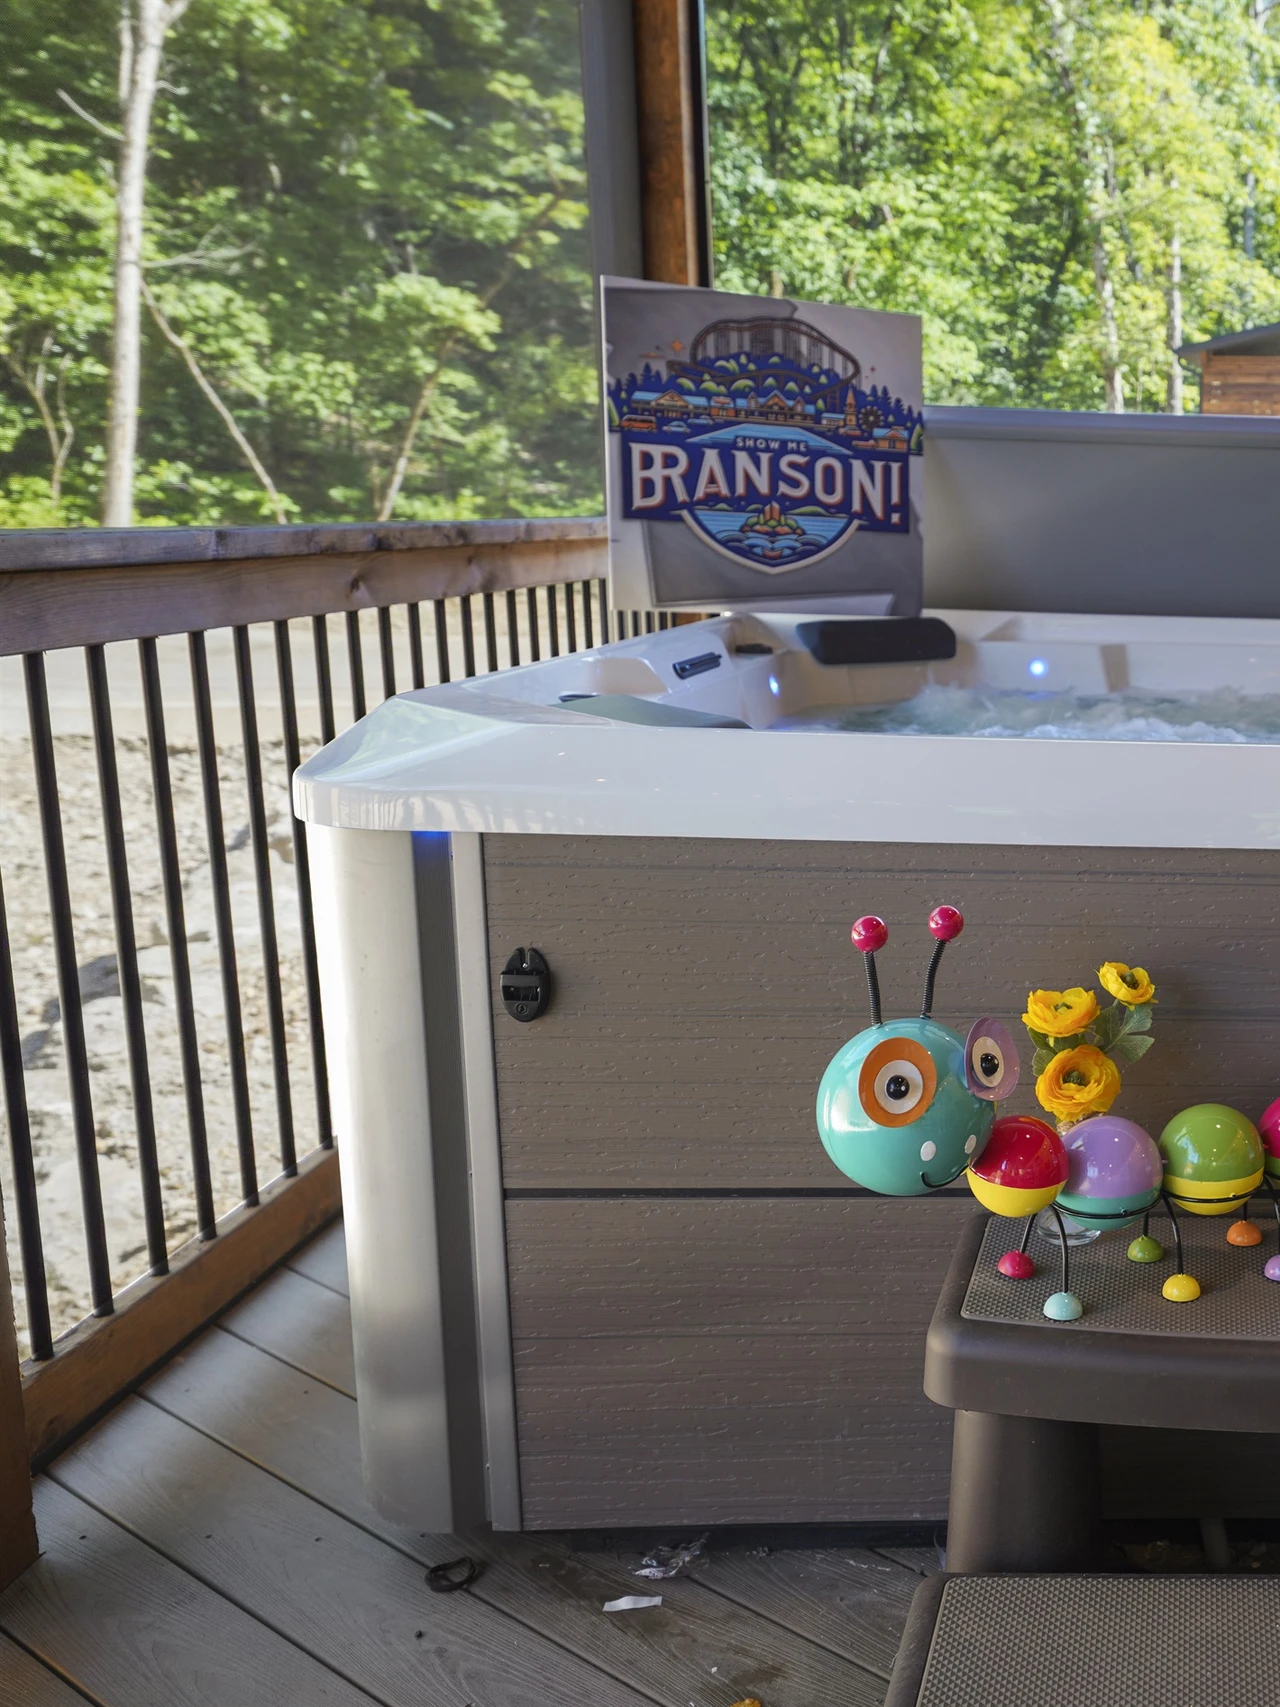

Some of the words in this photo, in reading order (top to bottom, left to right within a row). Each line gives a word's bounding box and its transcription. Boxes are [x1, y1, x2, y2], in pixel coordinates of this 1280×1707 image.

[736, 437, 780, 450] SHOW
[787, 440, 807, 452] ME
[628, 441, 903, 526] BRANSON!
